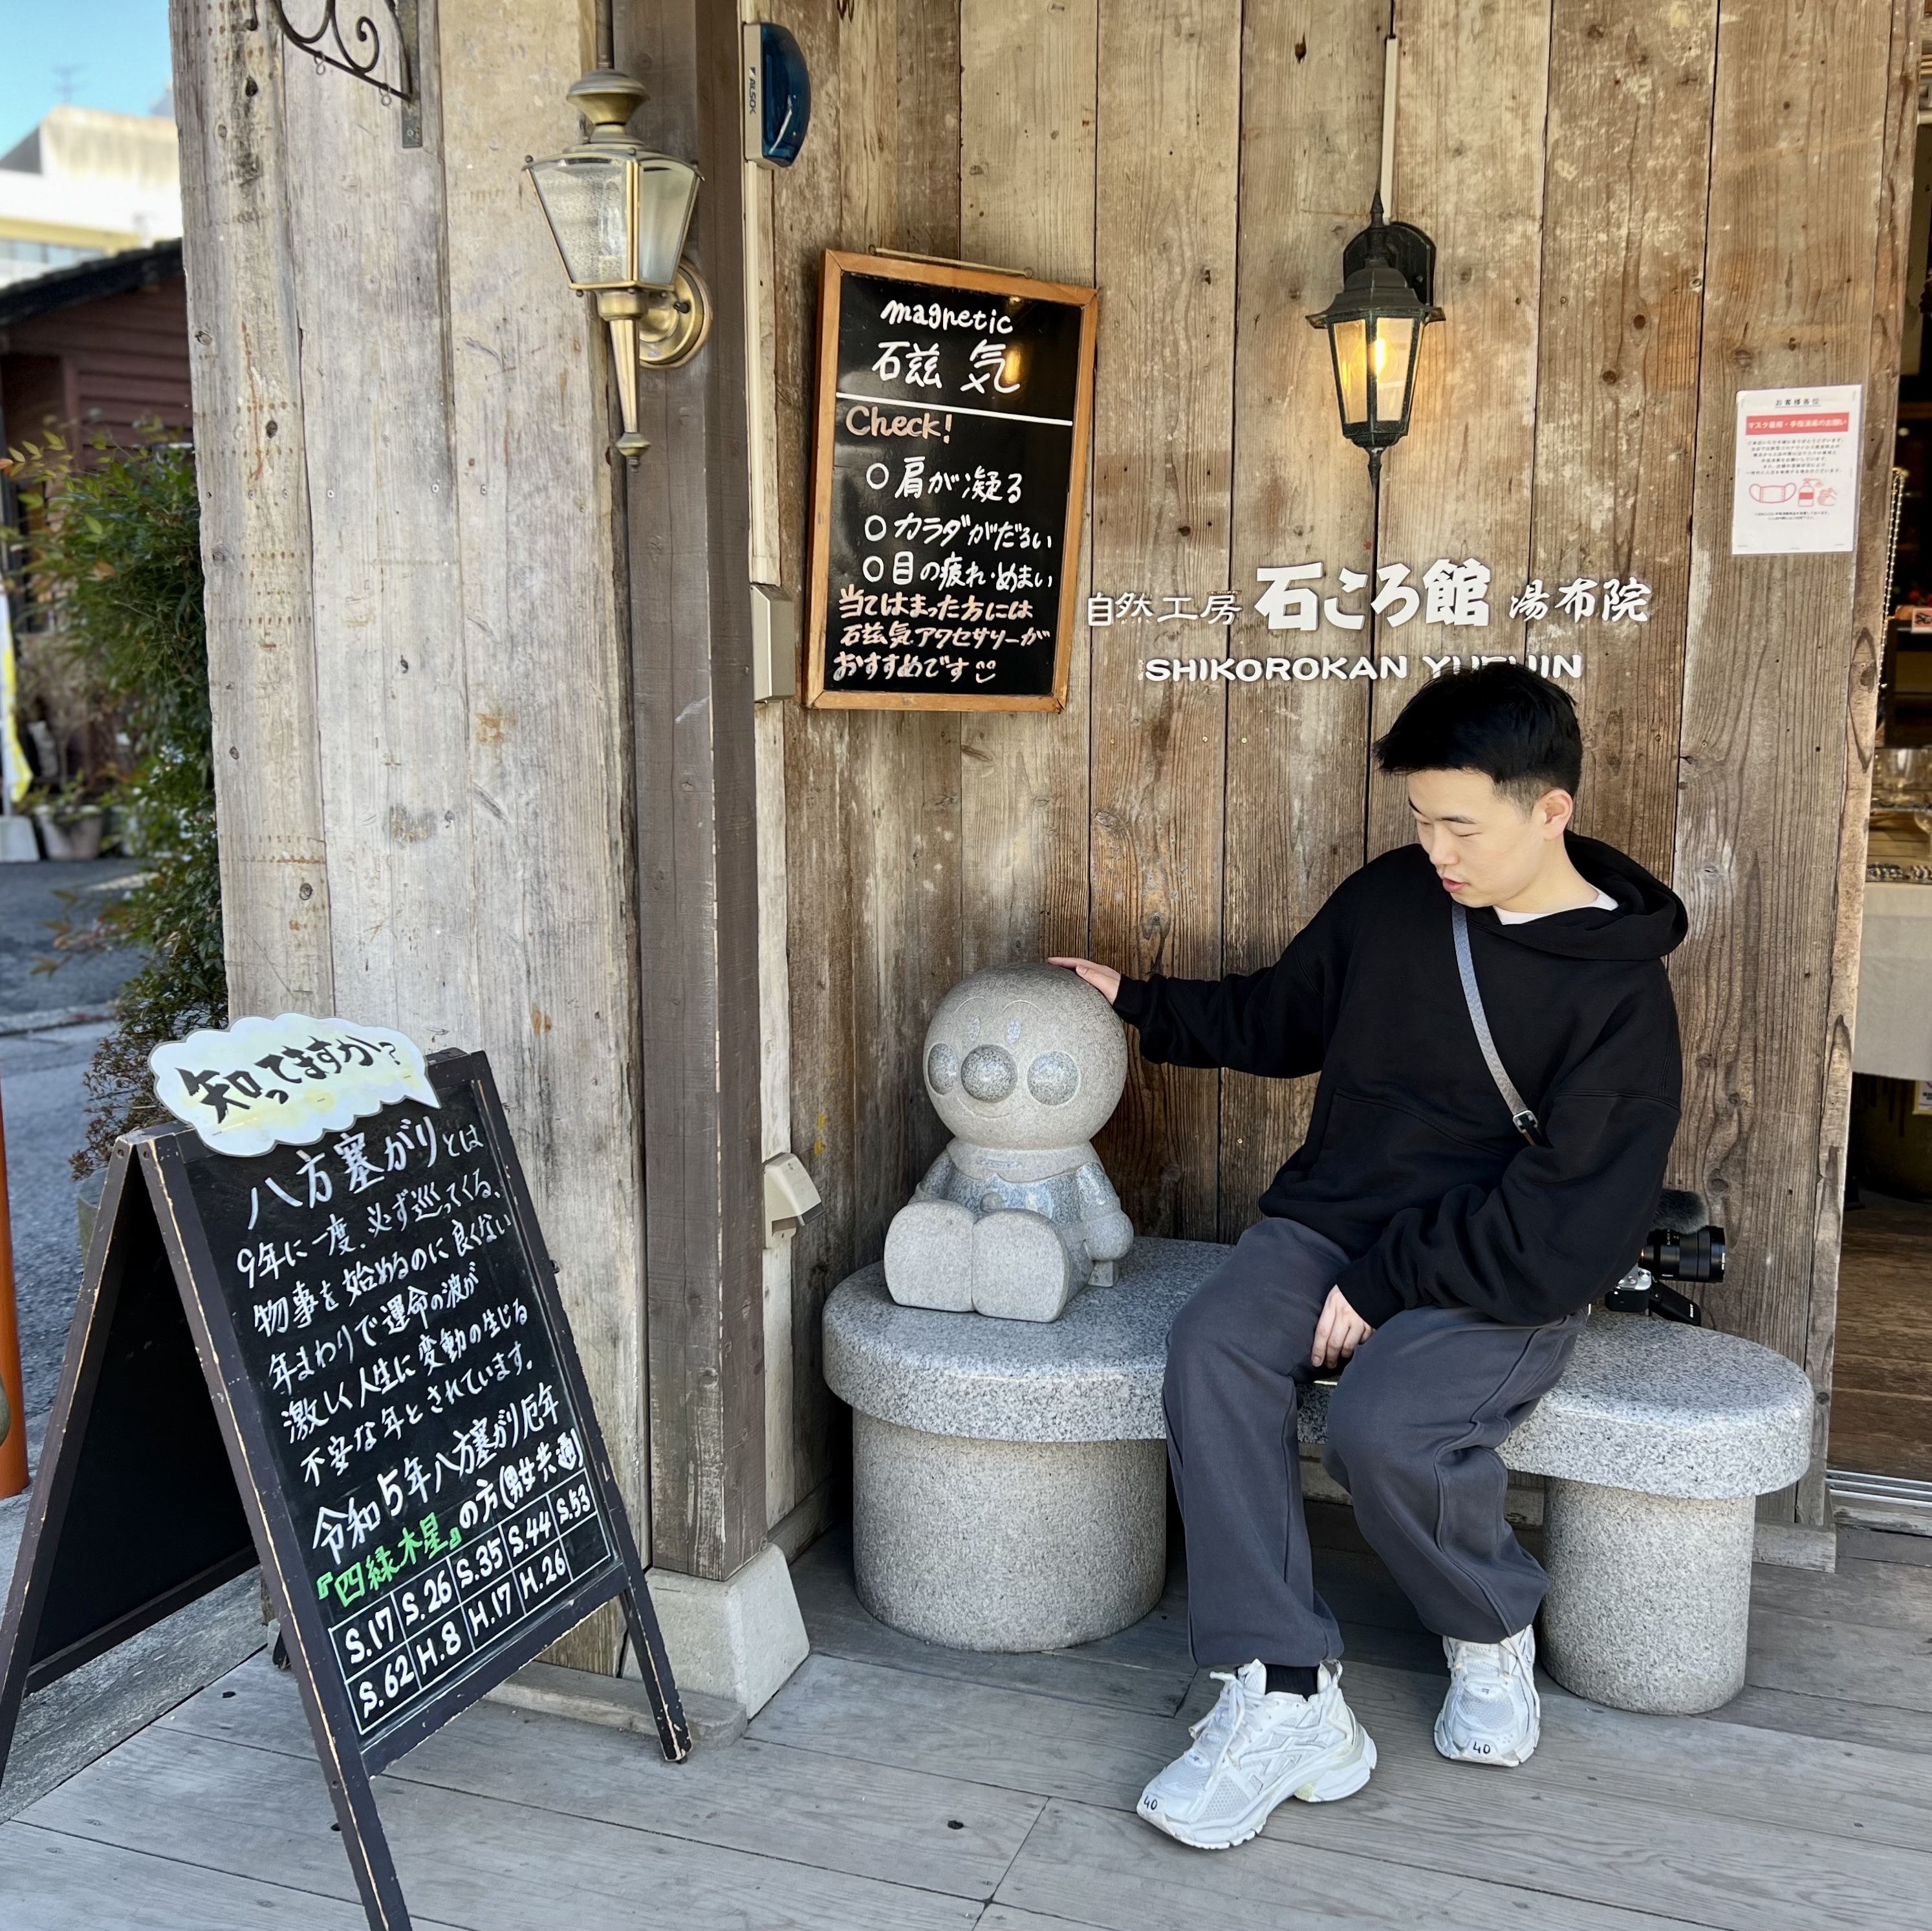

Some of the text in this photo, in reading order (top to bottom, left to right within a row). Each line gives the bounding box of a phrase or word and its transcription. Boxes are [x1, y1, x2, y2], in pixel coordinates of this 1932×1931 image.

[748, 78, 757, 115] ALSOK
[880, 299, 1014, 334] magnetic
[845, 405, 953, 444] Check!
[894, 455, 1023, 504] 肩が凝る
[894, 512, 1052, 551] カラダがだるい
[838, 583, 1033, 621] 当てはまった方には
[1254, 557, 1491, 631] 石ころ館
[1508, 576, 1652, 623] 湯布院
[833, 651, 970, 682] おすすめです
[345, 1484, 591, 1664] S.17 S.26 S.35 S.44 S.53
[359, 1548, 566, 1718] S.62 H.8 H.17 H.26
[1472, 1741, 1491, 1754] 40
[1143, 1795, 1158, 1810] 40
